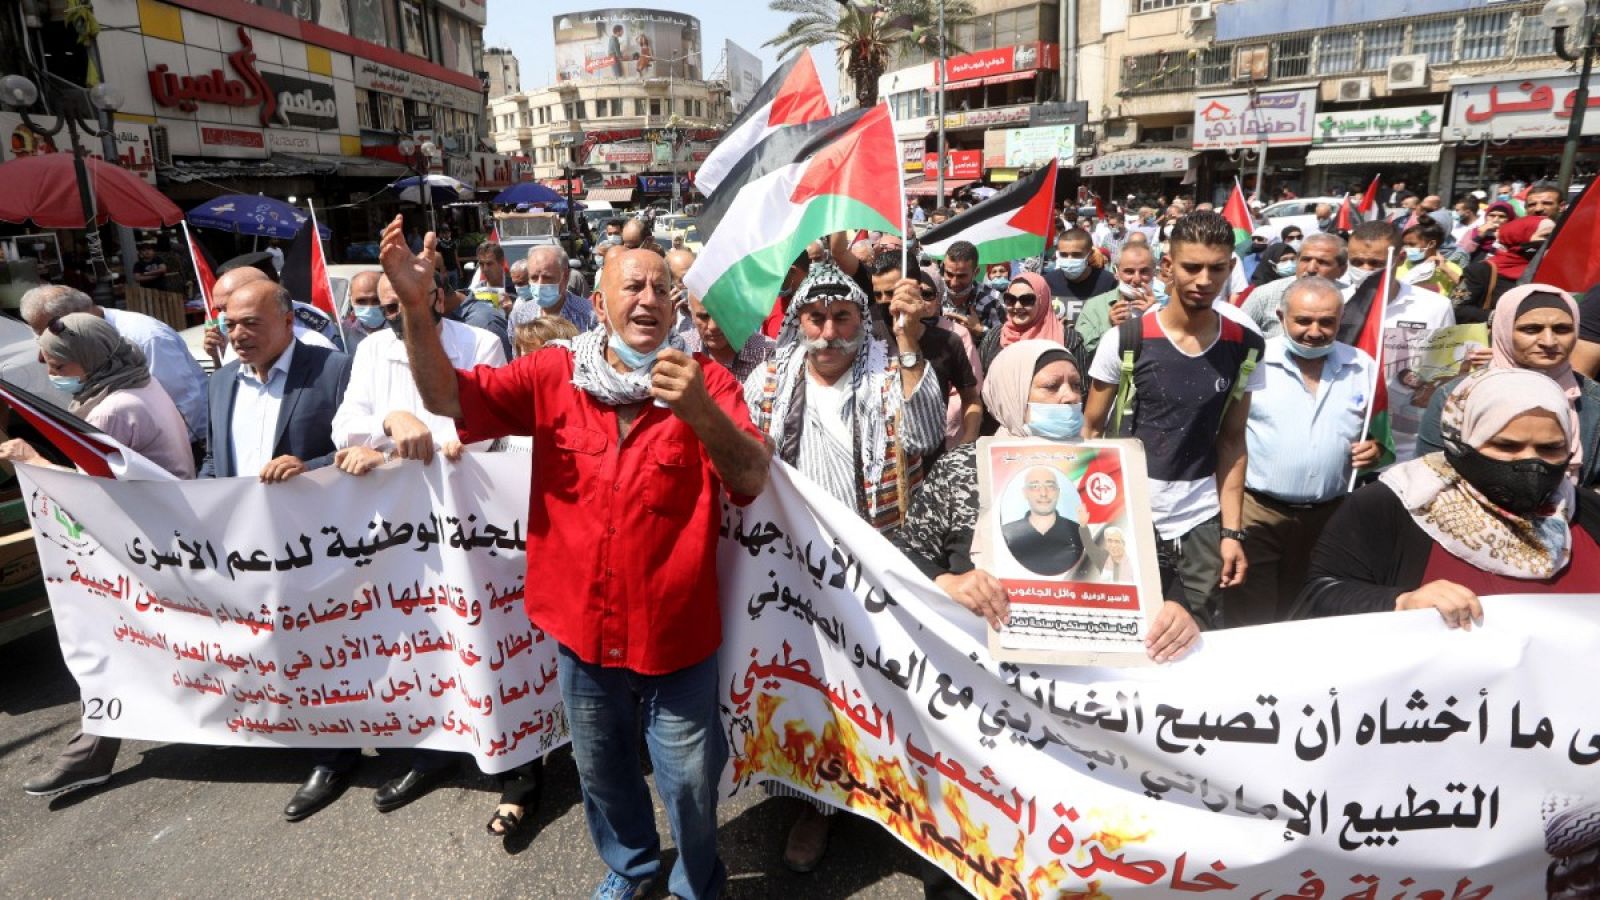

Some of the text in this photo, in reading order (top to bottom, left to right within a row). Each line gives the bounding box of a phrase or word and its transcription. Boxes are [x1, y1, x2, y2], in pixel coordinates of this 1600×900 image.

[277, 89, 336, 128] مطعم
[1204, 101, 1307, 140] أصفهاني
[1375, 115, 1414, 133] صيدلية
[1100, 155, 1166, 172] معرض زهران
[125, 511, 526, 581] لجنة الوطنية لدعم الأسرى
[277, 584, 381, 631] الوضاءة
[747, 569, 847, 649] الصهيوني
[1053, 588, 1077, 600] وائل
[112, 615, 170, 652] الصهيوني
[172, 640, 210, 661] العدو
[320, 633, 370, 670] الأول
[373, 630, 458, 662] المقاومة
[214, 642, 277, 676] مواجهة
[283, 651, 313, 680] في
[850, 643, 928, 694] العدو
[171, 670, 228, 696] الشهداء
[231, 683, 293, 709] جثامين
[296, 678, 375, 707] استعادة
[381, 667, 422, 703] أجل
[429, 672, 457, 698] من
[729, 639, 896, 746] الفلسطيني
[927, 673, 975, 721] مع
[1000, 661, 1145, 735] الخيانة
[225, 708, 303, 734] الصهيوني
[308, 717, 353, 736] العدو
[359, 711, 401, 737] قيود
[407, 712, 436, 735] من
[485, 709, 553, 757] وتحرير
[1155, 693, 1282, 756] تصبح
[1294, 687, 1341, 762] أن
[1355, 687, 1489, 746] أخشاه
[1510, 700, 1555, 749] ما
[905, 732, 1037, 836] الشعب
[1338, 782, 1500, 852] التطبيع
[1047, 801, 1241, 893] خاصرة
